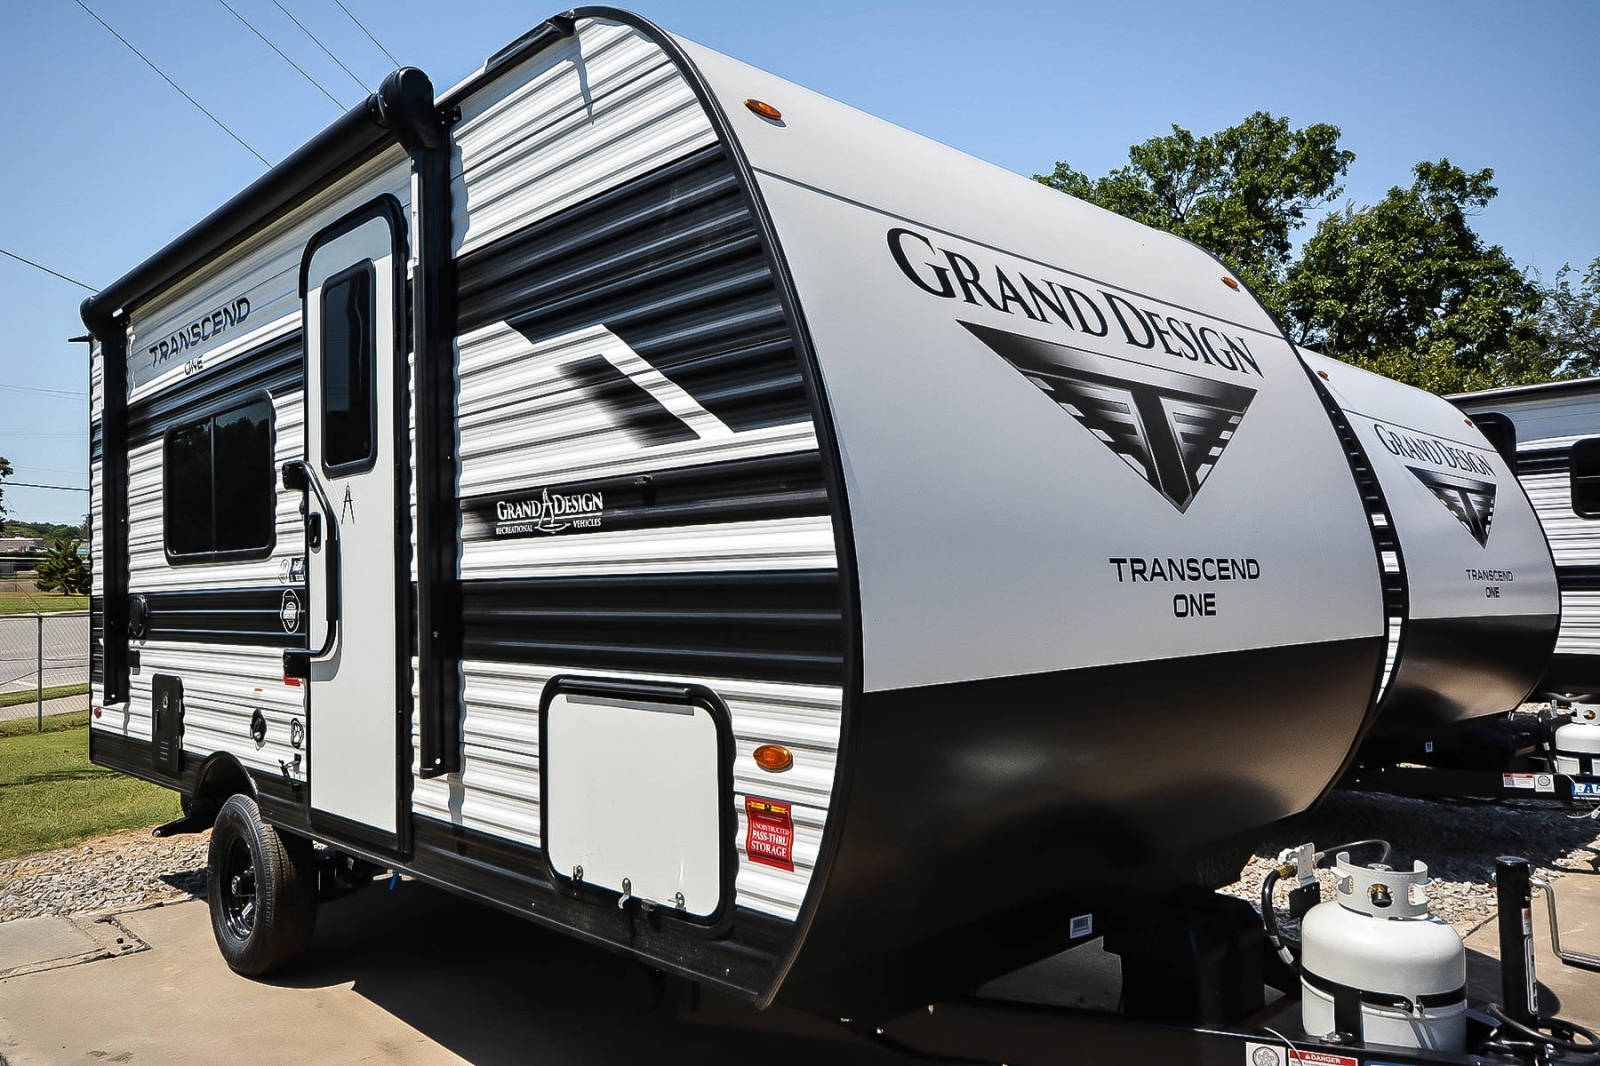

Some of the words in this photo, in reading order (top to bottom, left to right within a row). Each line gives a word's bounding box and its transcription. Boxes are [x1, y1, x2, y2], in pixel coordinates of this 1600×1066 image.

[886, 227, 1109, 338] GRAND
[1096, 288, 1264, 379] DESIGN
[149, 297, 251, 367] TRANSCEND
[184, 355, 204, 375] ONE
[1374, 423, 1443, 465] GRAND
[1432, 439, 1497, 478] DESIGN
[496, 501, 541, 520] GRAND
[551, 492, 603, 514] DESIGN
[495, 524, 534, 535] RECREATIONAL
[572, 518, 601, 528] VEHICLES
[1109, 557, 1260, 582] TRANSCEND
[1465, 569, 1514, 582] TRANSCEND
[1485, 586, 1500, 598] ONE
[1173, 593, 1217, 618] ONE
[751, 840, 787, 857] STORAGE
[752, 830, 788, 847] PASS-THRU
[1310, 1054, 1341, 1064] DANGER
